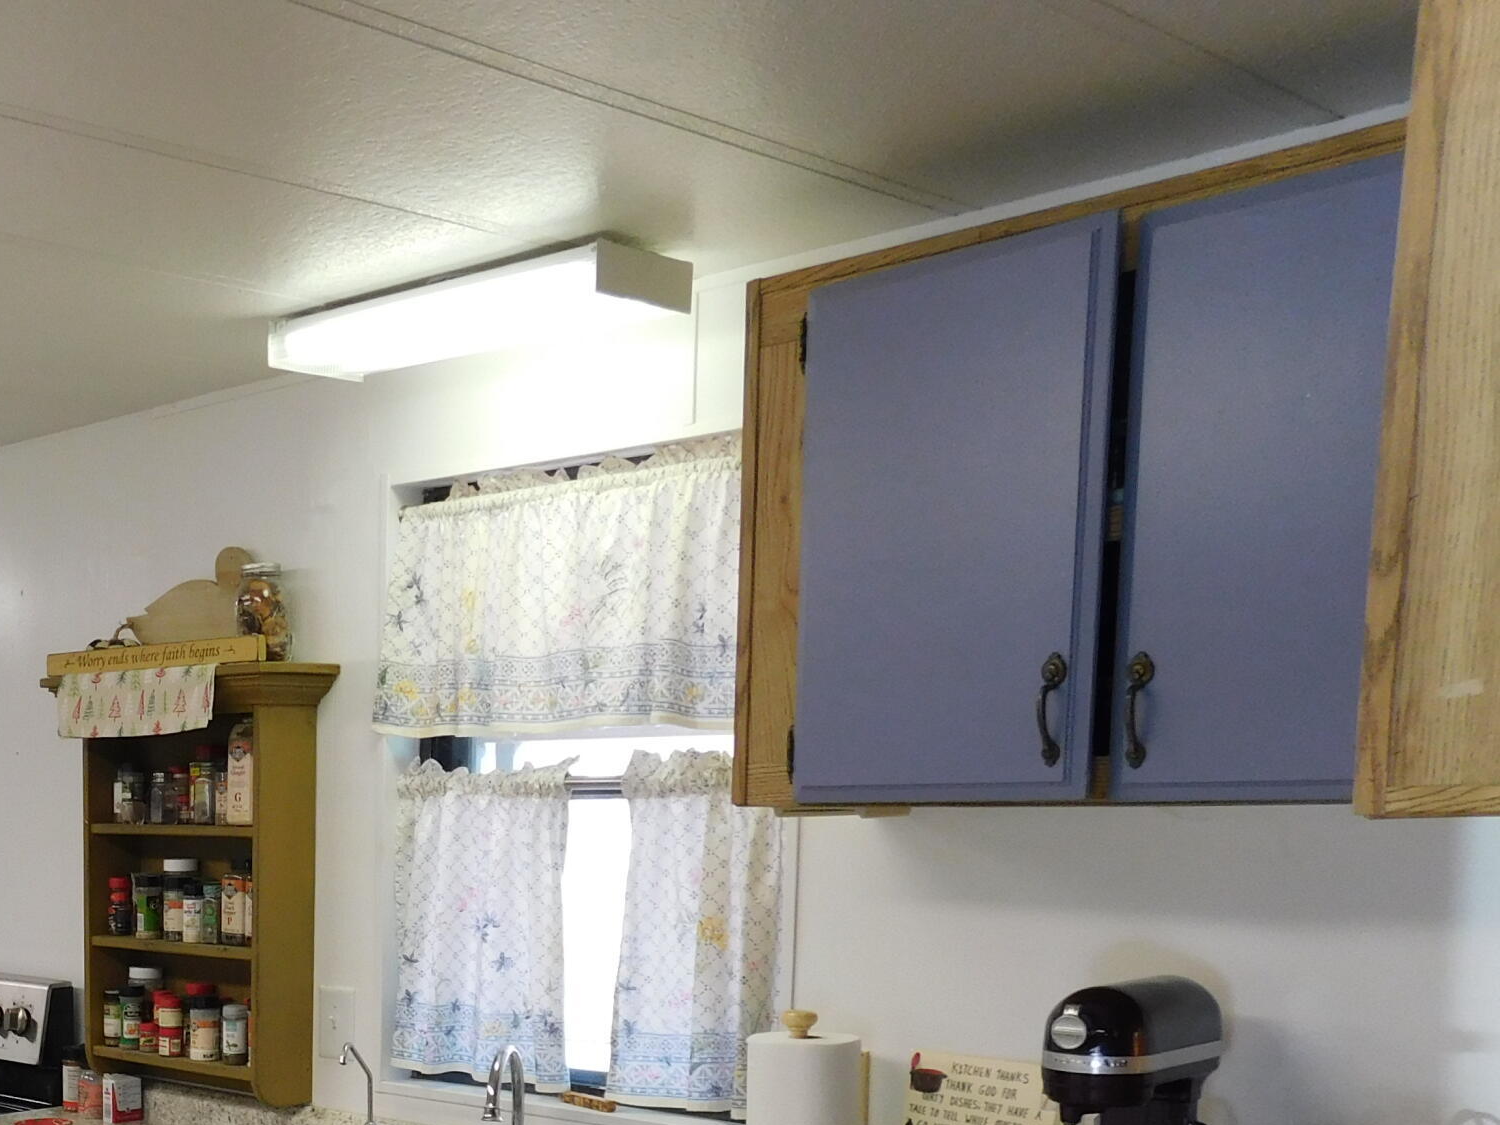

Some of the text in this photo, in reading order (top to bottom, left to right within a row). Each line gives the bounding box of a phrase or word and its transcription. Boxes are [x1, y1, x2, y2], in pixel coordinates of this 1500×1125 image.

[77, 645, 221, 669] Worry ends where faith begins
[951, 1061, 1030, 1085] KITCHEN THANKS
[945, 1079, 1018, 1101] THANK GOD FOR
[1006, 1105, 1031, 1120] HAVE
[1034, 1110, 1042, 1121] A
